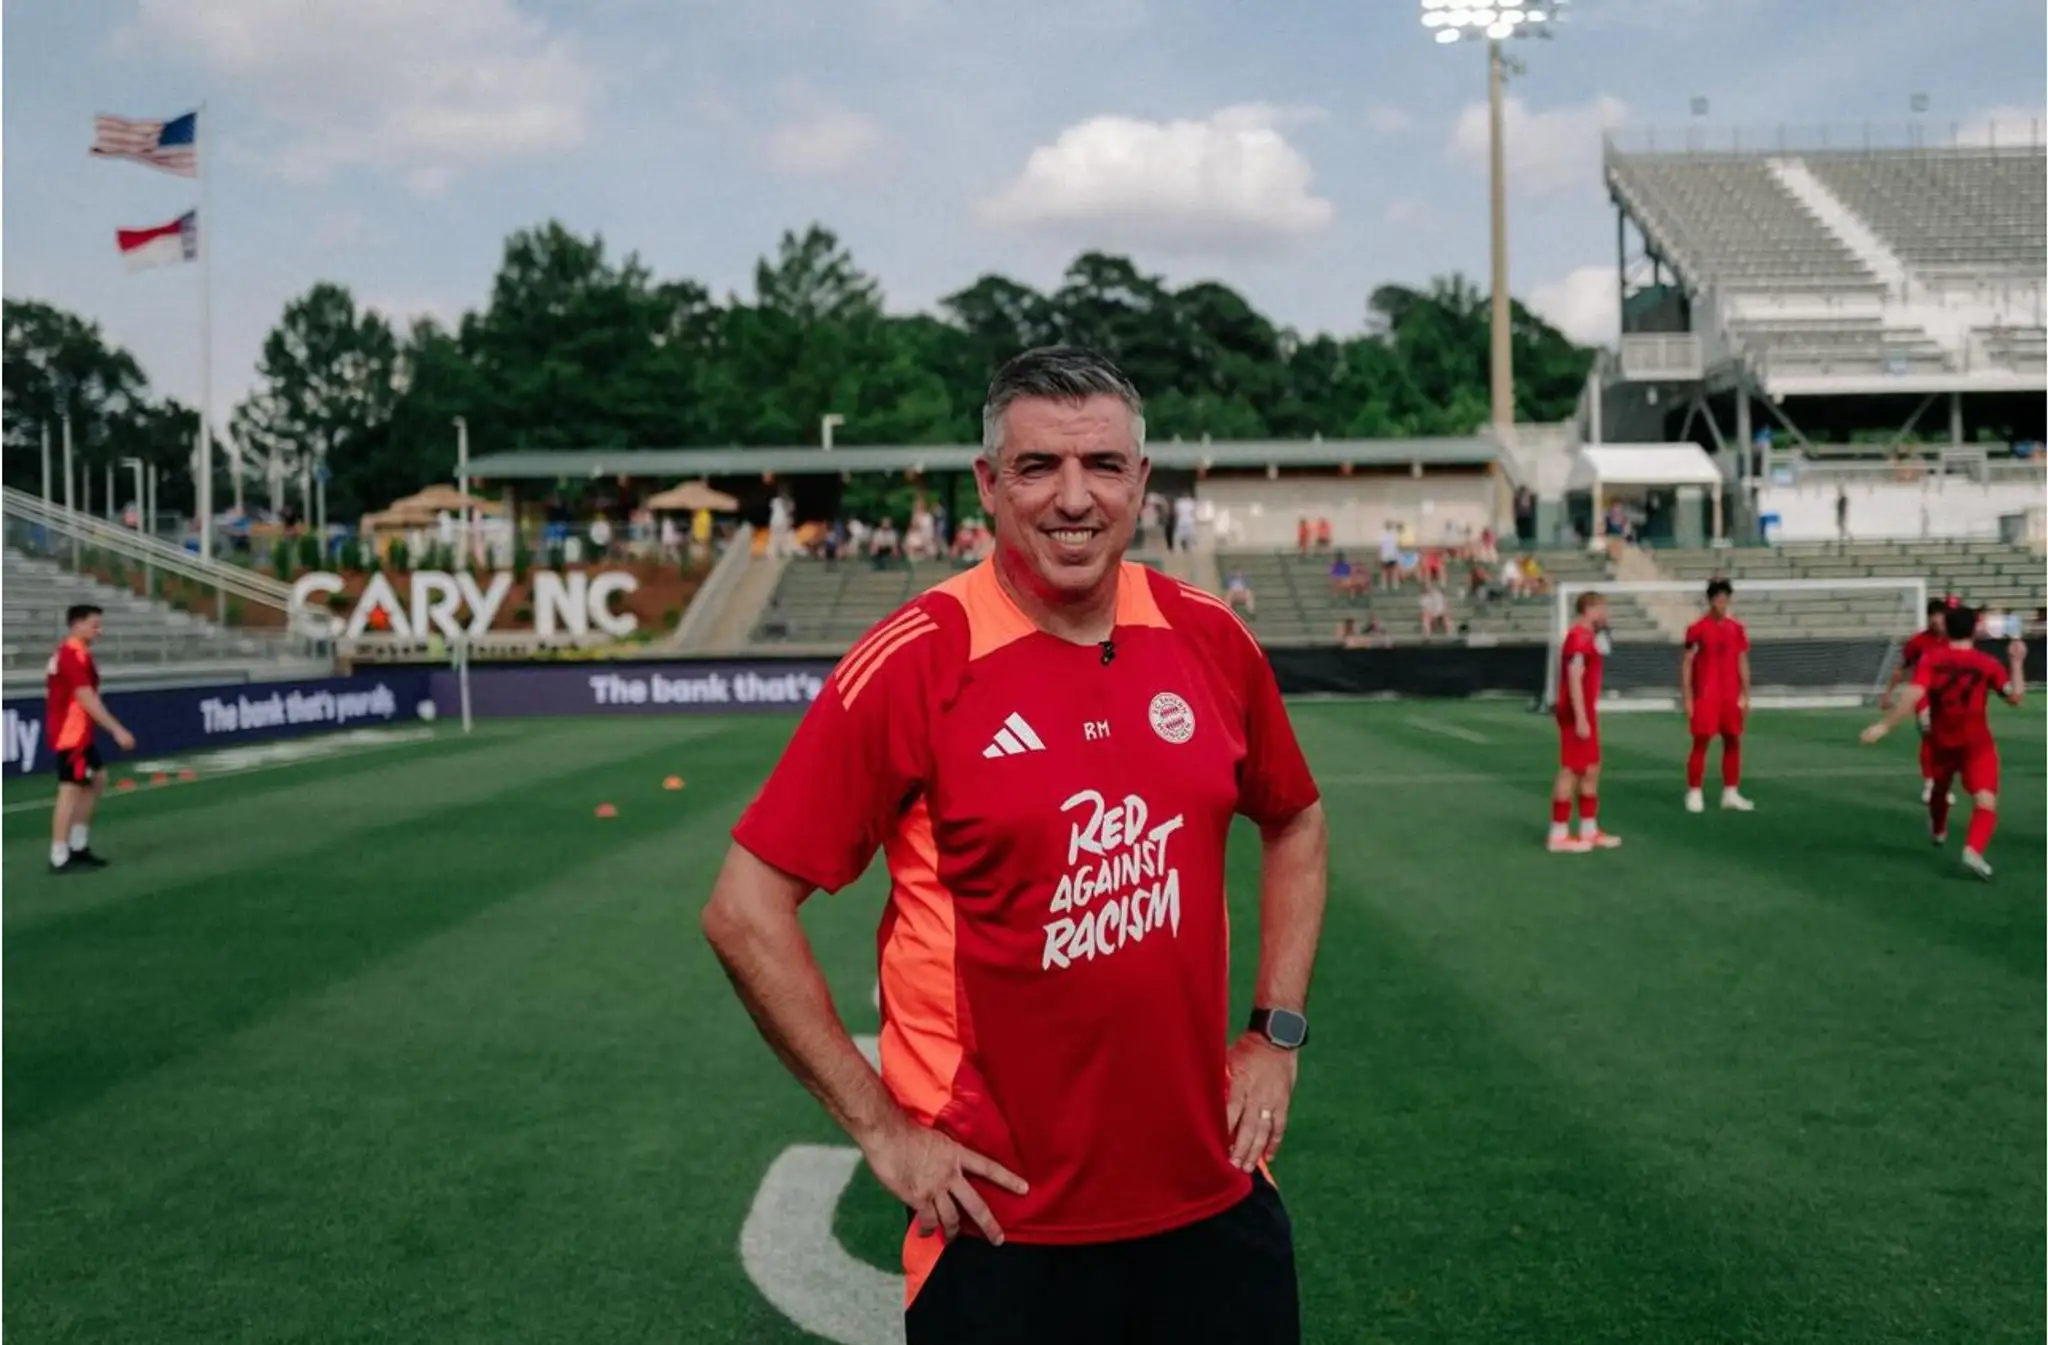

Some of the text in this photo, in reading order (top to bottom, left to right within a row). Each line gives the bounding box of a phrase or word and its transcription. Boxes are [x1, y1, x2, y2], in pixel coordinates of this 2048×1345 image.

[289, 570, 638, 642] CARY NC
[200, 697, 237, 734] The
[238, 693, 285, 729] bank
[587, 672, 648, 704] The
[650, 671, 729, 704] bank
[1083, 719, 1111, 741] RM
[1050, 813, 1184, 914] AGAINST
[1060, 789, 1149, 867] RED
[1042, 868, 1181, 971] RACISM
